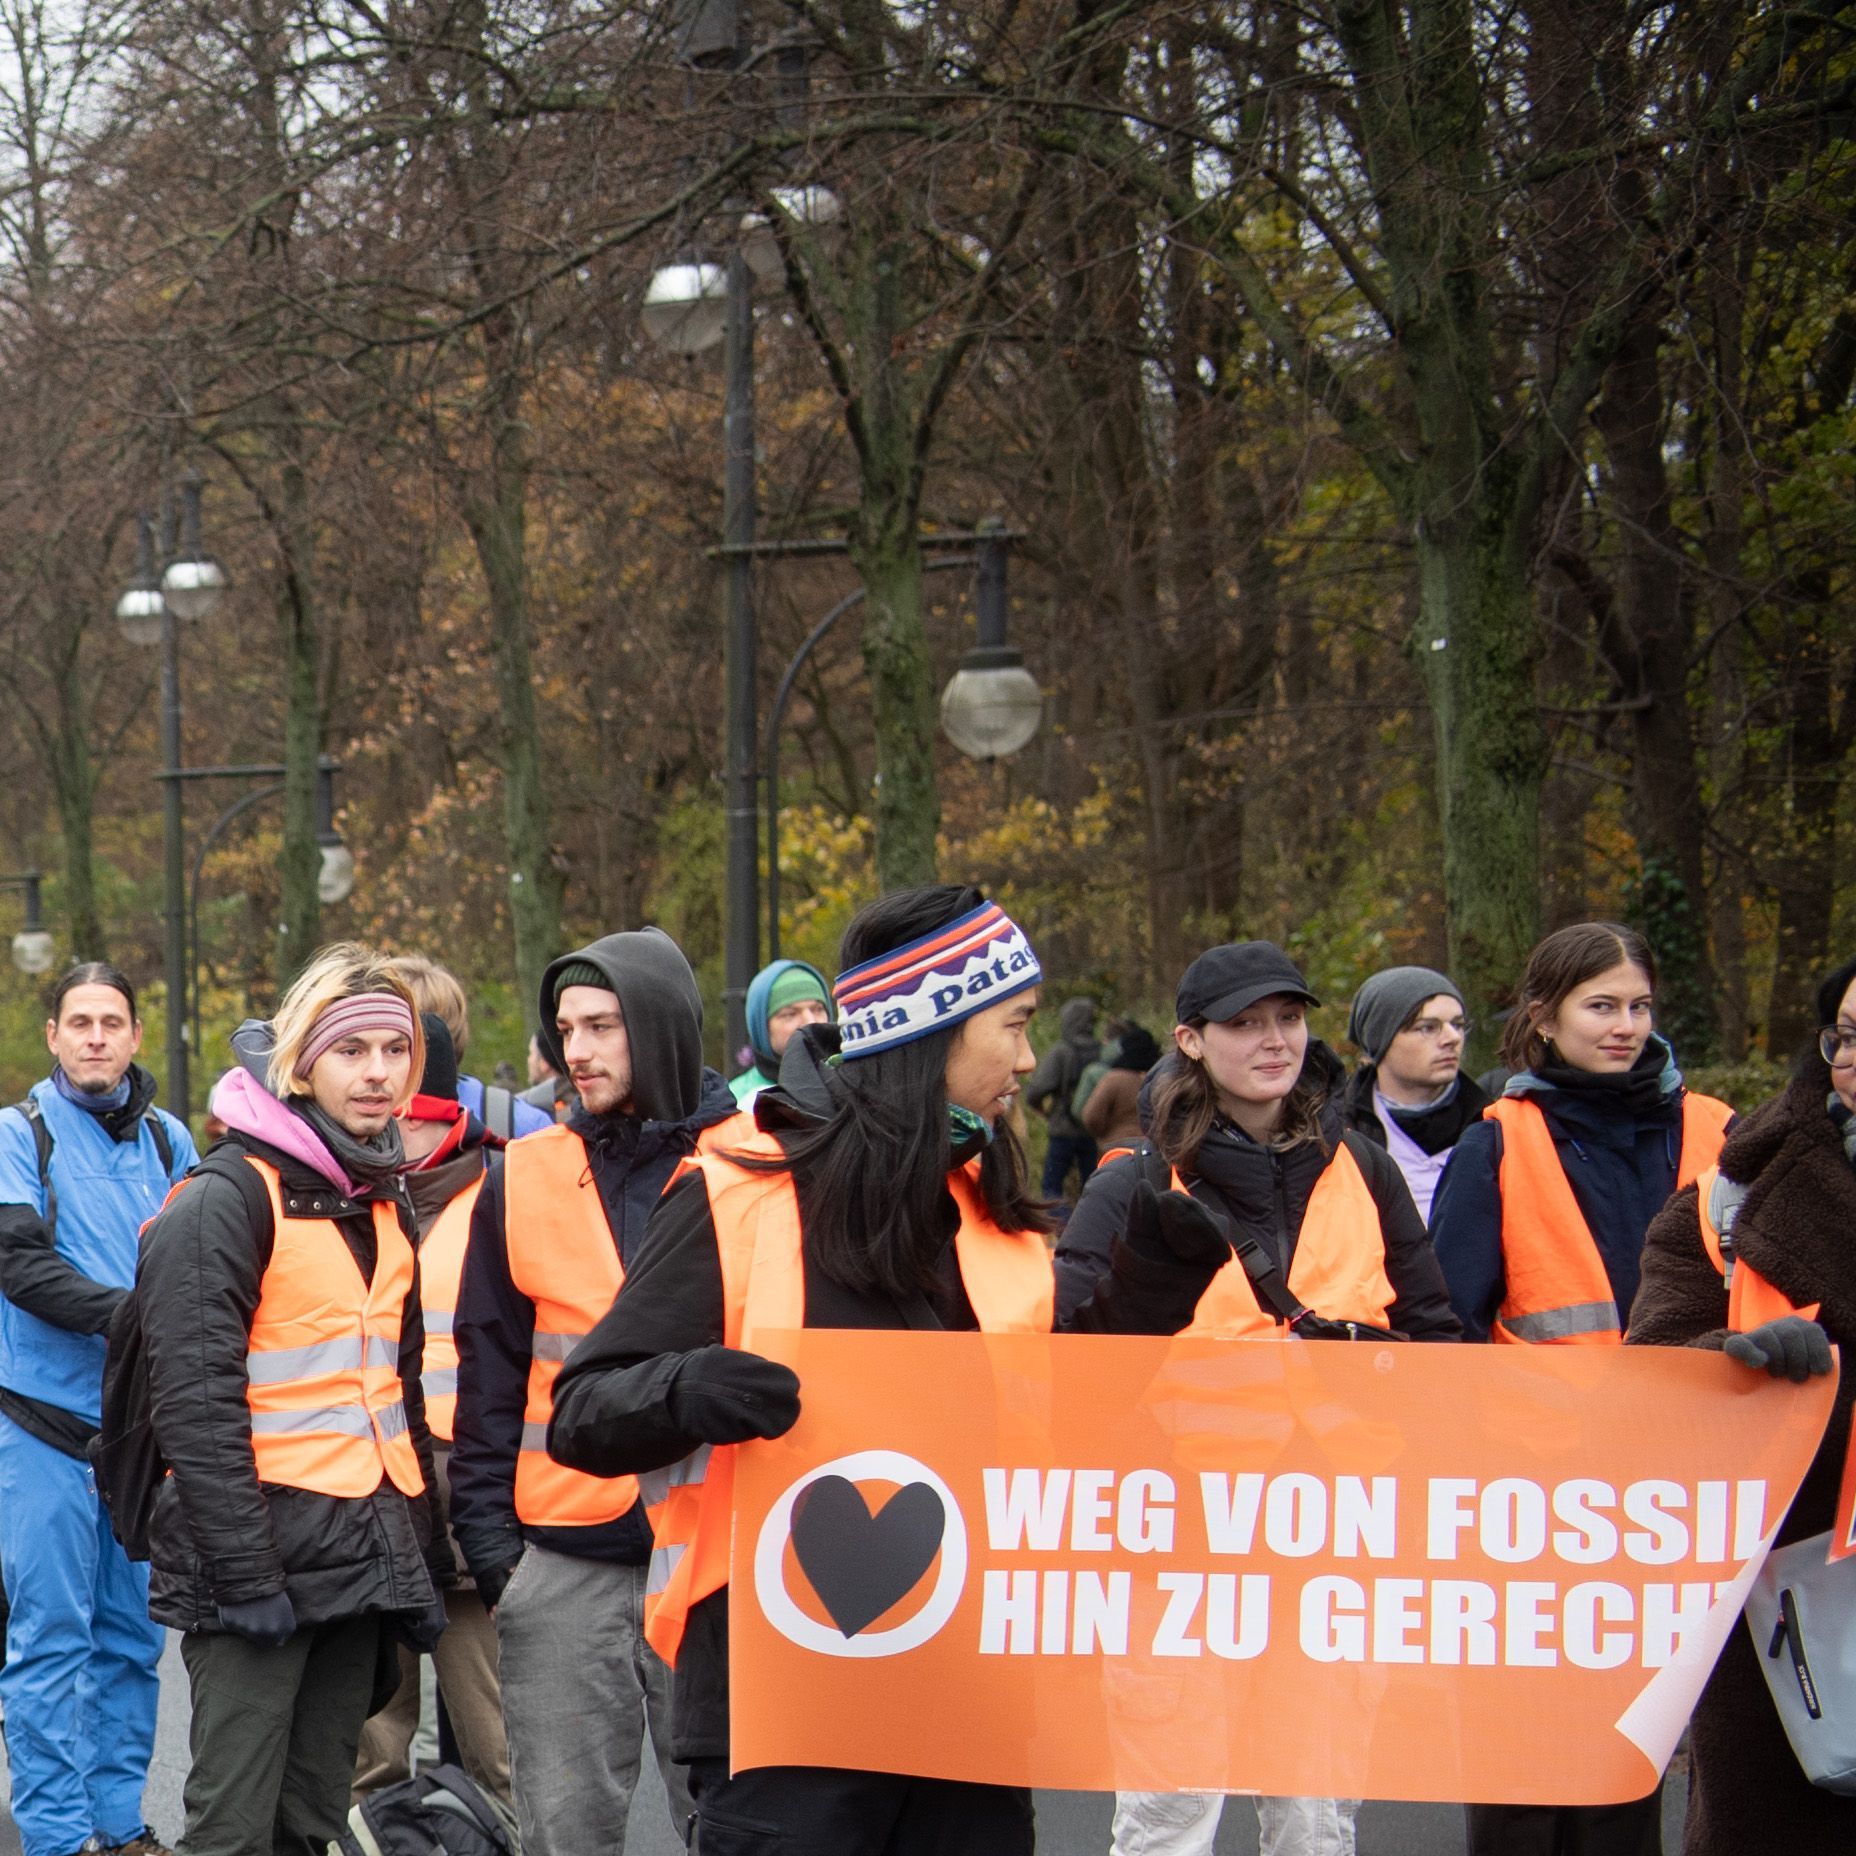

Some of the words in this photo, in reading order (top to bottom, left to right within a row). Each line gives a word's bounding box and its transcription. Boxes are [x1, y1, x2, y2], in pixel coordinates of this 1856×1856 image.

[983, 1468, 1175, 1554] WEG
[1201, 1473, 1398, 1560] VON
[978, 1570, 1132, 1656] HIN
[1153, 1573, 1270, 1659] ZU
[1299, 1579, 1733, 1668] GERECH
